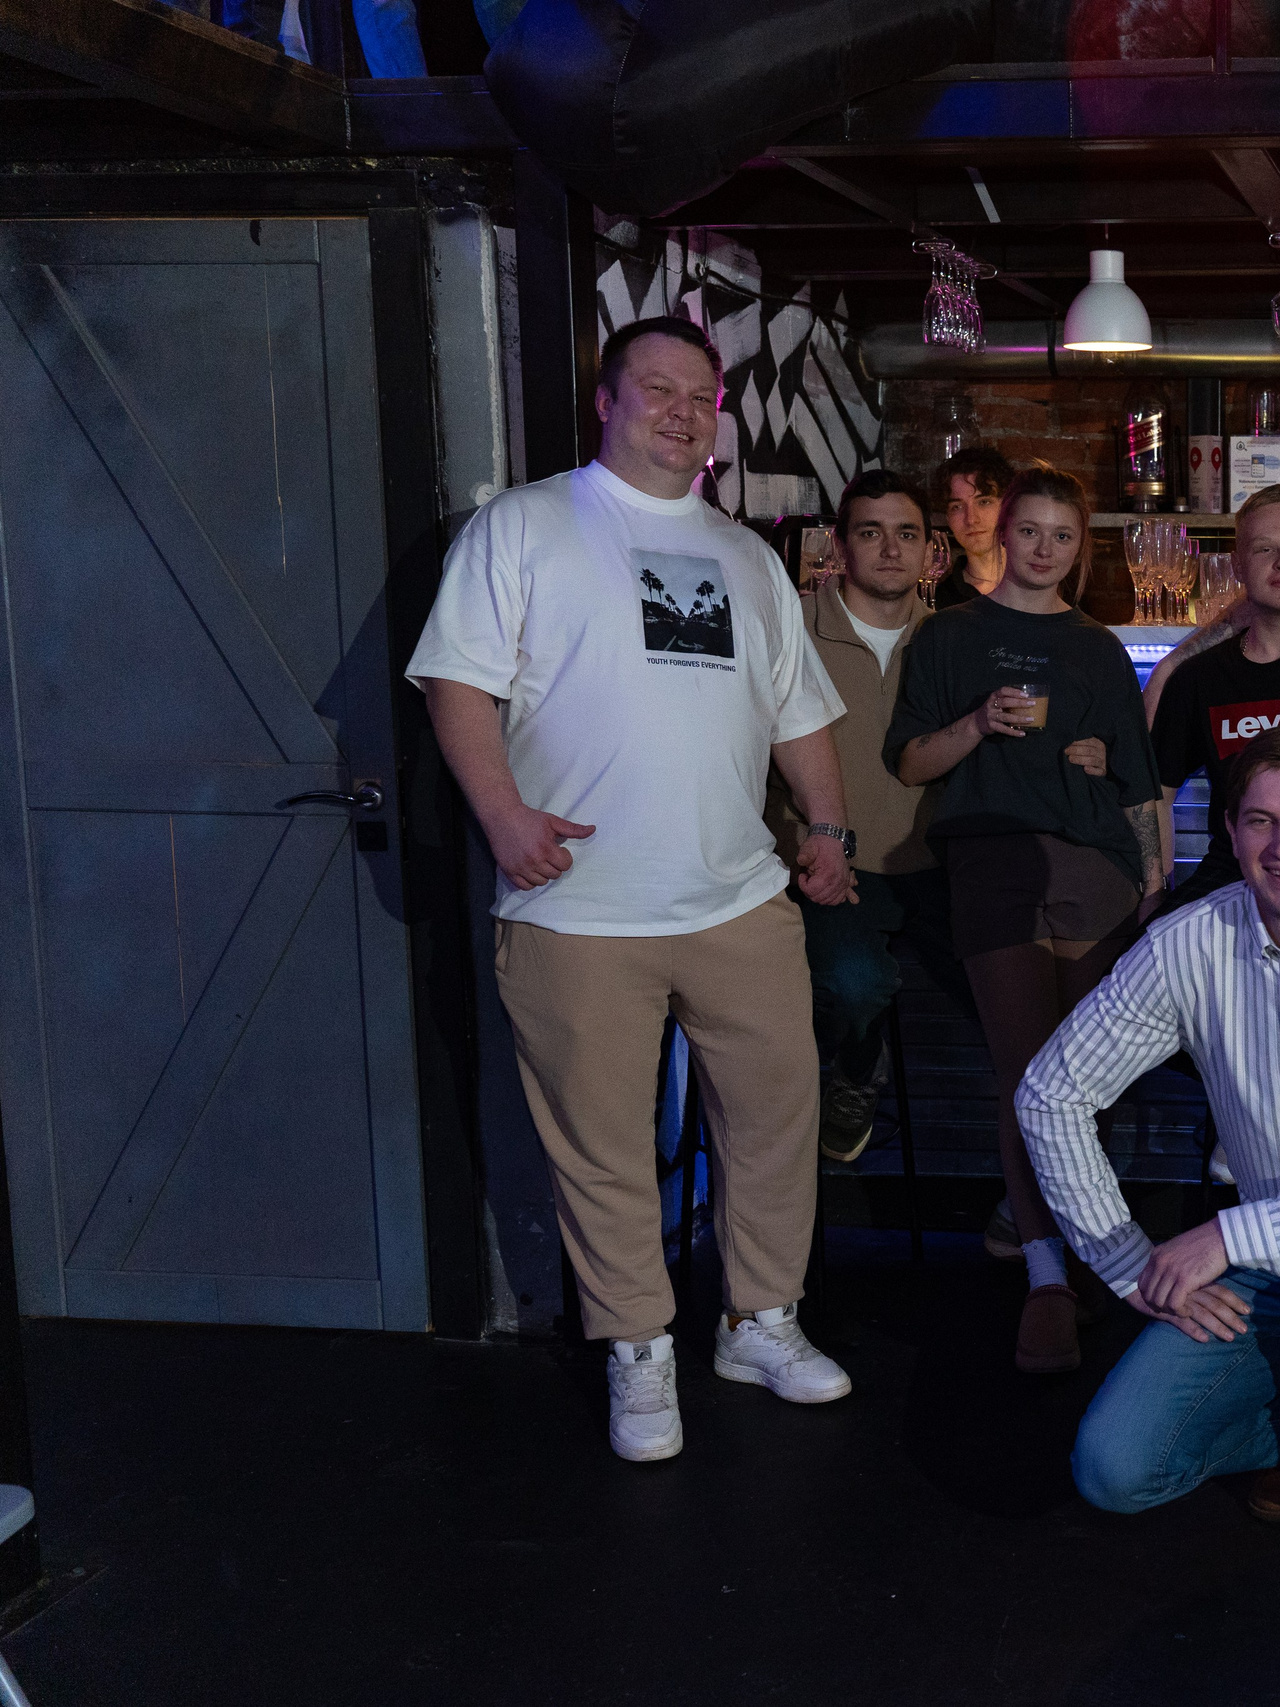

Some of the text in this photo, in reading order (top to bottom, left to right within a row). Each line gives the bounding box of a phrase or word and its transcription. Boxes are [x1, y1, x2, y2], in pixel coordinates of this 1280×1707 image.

[646, 657, 737, 672] YOUTH FORGIVES EVERYTHING
